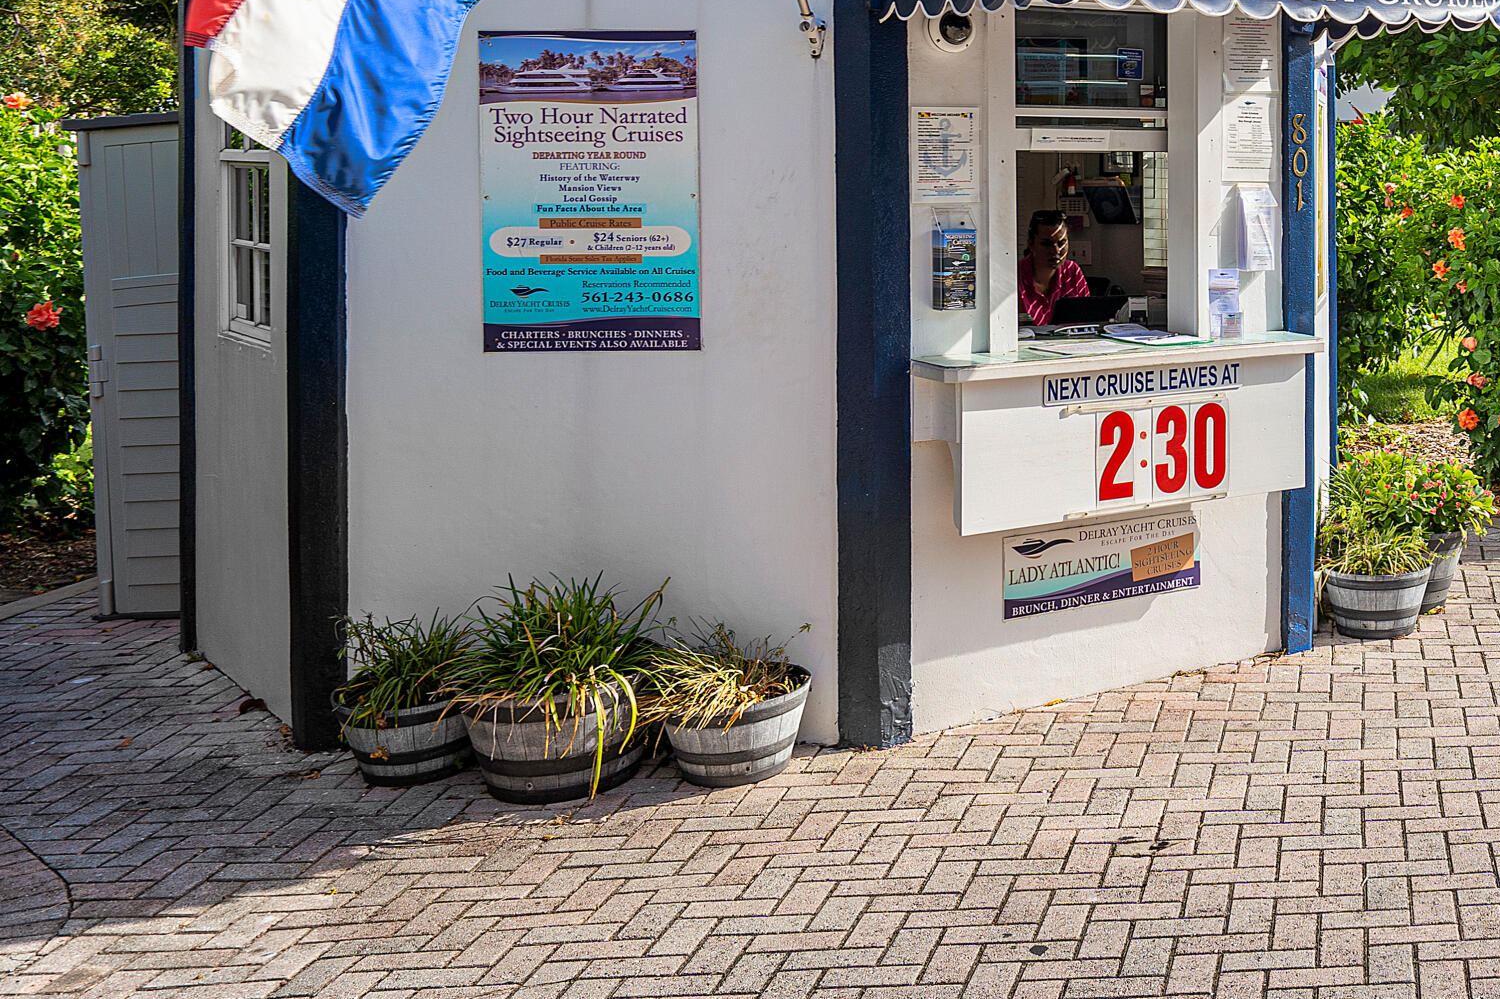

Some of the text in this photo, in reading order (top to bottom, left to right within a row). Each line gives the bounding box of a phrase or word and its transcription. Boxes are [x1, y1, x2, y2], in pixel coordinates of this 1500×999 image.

[489, 106, 688, 125] Two Hour Narrated
[494, 125, 684, 148] Sightseeing Cruises
[532, 151, 647, 160] DEPARTING YEAR ROUND
[560, 162, 620, 171] FEATURING:
[1292, 113, 1308, 211] 801
[540, 174, 571, 183] History
[599, 174, 640, 183] Waterway
[563, 194, 618, 203] Local Gossip
[550, 219, 632, 228] Public Cruise Rates
[506, 237, 562, 248] $27 Regular
[593, 232, 669, 243] $24 Seniors (62+)
[486, 268, 508, 276] Food
[510, 268, 526, 276] and
[528, 268, 566, 277] Beverage
[599, 267, 638, 275] Available
[651, 267, 663, 275] All
[664, 267, 696, 275] Cruises
[582, 280, 691, 288] Reservations Recommended
[581, 290, 694, 303] 561-243-0686
[490, 300, 570, 308] DELRAY YACHT CRUISES
[501, 330, 683, 340] CHARTERS BRUNCHES DINNERS
[496, 340, 689, 349] & SPECIAL EVENTS ALSO AVAILABLE
[1047, 362, 1240, 402] NEXT CRUISE LEAVES AT
[1099, 402, 1227, 502] 2:30
[1079, 515, 1197, 542] DELRAY YACHT CRUISES
[1134, 548, 1192, 569] SIGHTSEEING
[1008, 551, 1121, 586] LADY ATLANTIC!
[1147, 559, 1182, 576] CRUISES
[1012, 576, 1195, 617] BRUNCH, DINNER & ENTERTAINMENT
